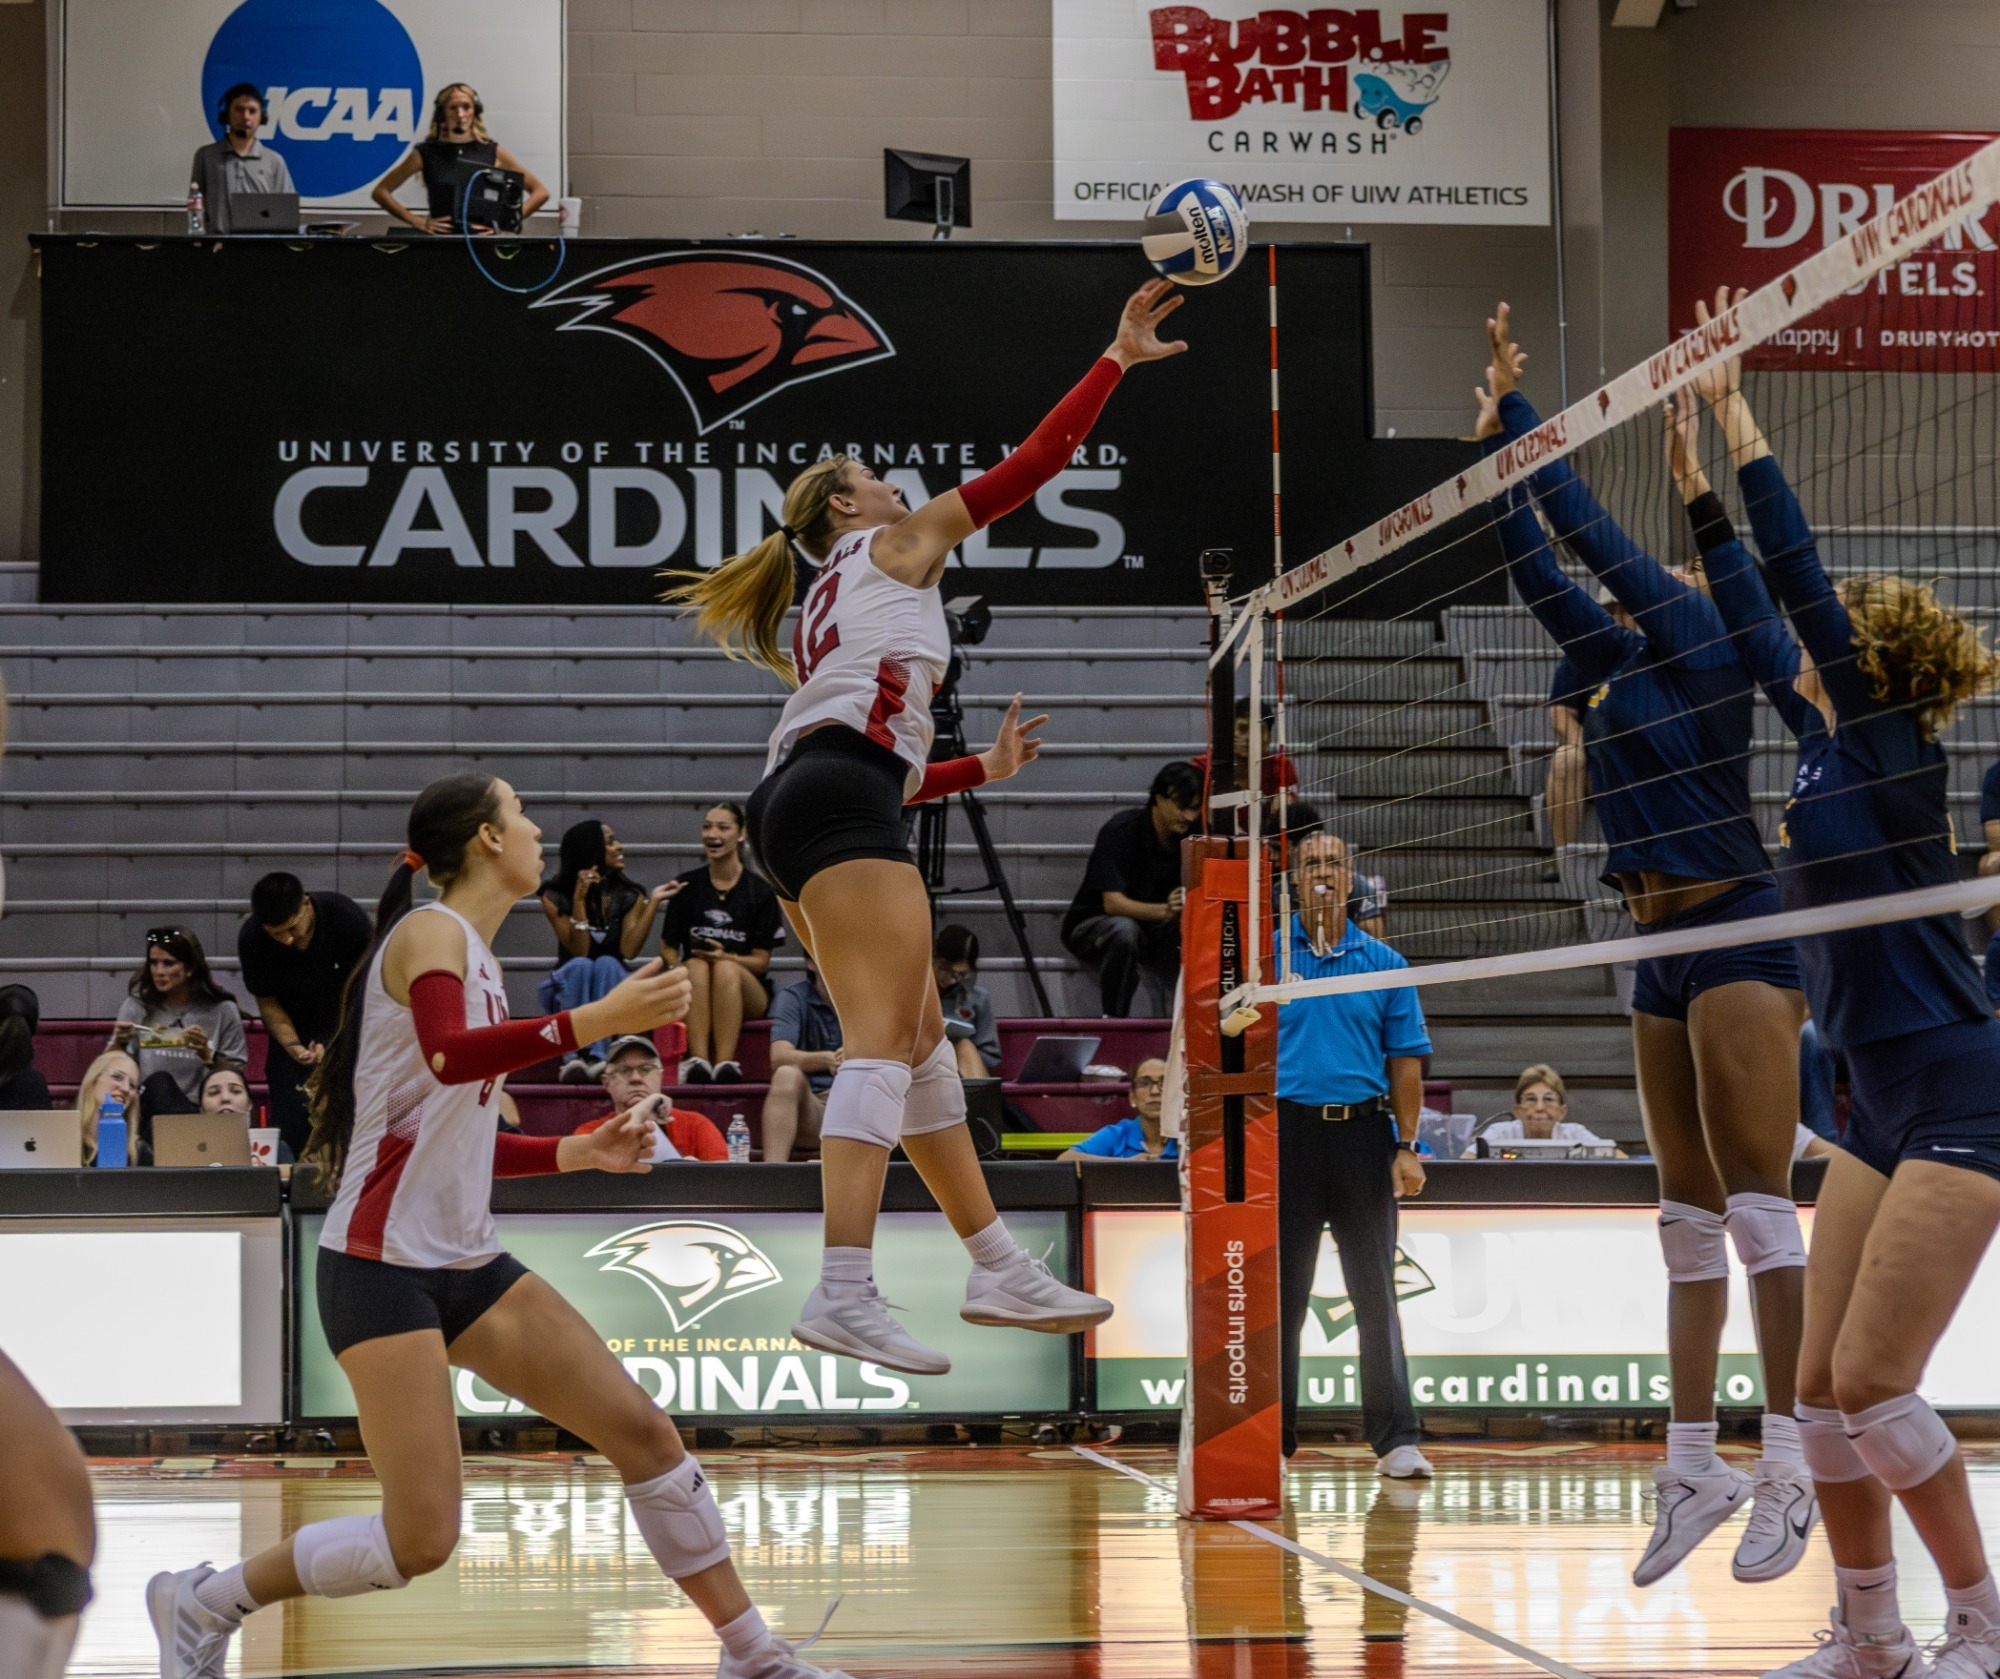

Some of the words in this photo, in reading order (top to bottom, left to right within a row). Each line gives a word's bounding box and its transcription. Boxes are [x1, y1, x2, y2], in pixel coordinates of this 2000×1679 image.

[1149, 6, 1449, 71] BUBBLE
[1184, 59, 1348, 121] BATH
[1074, 181, 1166, 201] OFFICIA
[1232, 184, 1304, 203] WASH
[1312, 184, 1344, 204] OF
[1351, 185, 1400, 204] UIW
[1408, 186, 1528, 206] ATHLETICS
[1189, 206, 1216, 264] molten
[278, 441, 535, 463] UNIVERSITY
[561, 442, 609, 463] OF
[635, 442, 710, 464] THE
[736, 443, 976, 466] INCARNATE
[1223, 1240, 1248, 1312] sports
[607, 1338, 636, 1353] OF
[644, 1338, 689, 1353] THE
[696, 1337, 811, 1352] INCARNA
[1224, 1316, 1249, 1404] imports
